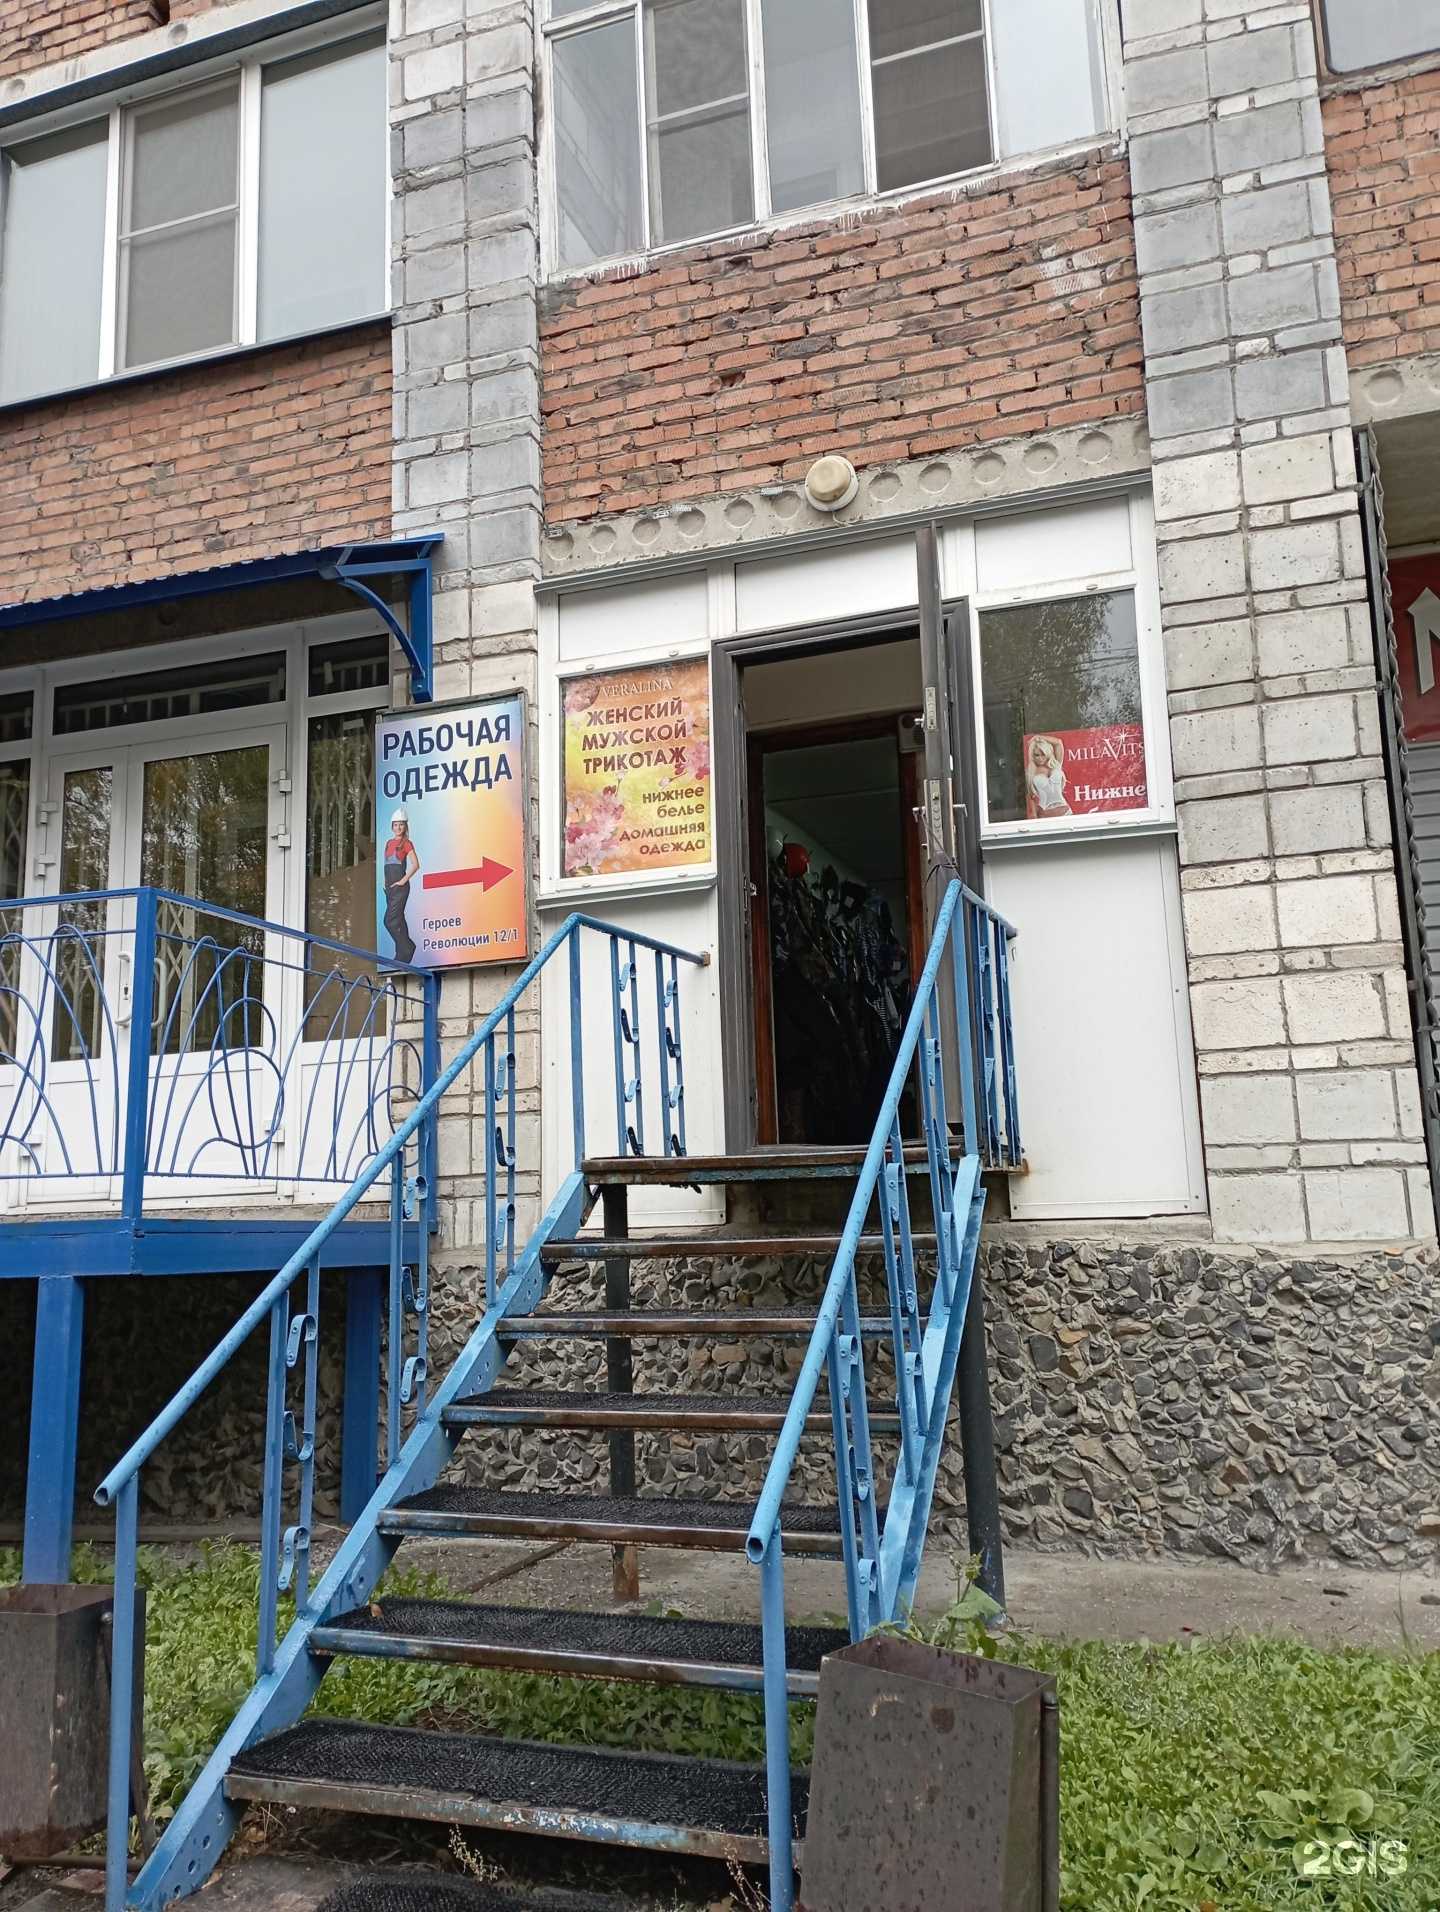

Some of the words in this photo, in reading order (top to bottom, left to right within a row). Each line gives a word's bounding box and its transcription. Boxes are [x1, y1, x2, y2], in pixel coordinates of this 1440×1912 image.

[601, 679, 673, 697] VERALINA
[586, 697, 682, 727] ЖЕНСКИЙ
[383, 714, 511, 760] РАБОЧАЯ
[582, 719, 687, 751] МУЖСКОЙ
[583, 746, 687, 775] ТРИКОТАЖ
[383, 753, 513, 802] ОДЕЖДА
[642, 785, 705, 804] нижнее
[656, 803, 705, 818] белье
[619, 821, 705, 842] домашняя
[639, 838, 706, 856] одежда
[422, 915, 462, 931] Героев
[423, 931, 490, 951] Революции
[493, 928, 518, 943] 12/1
